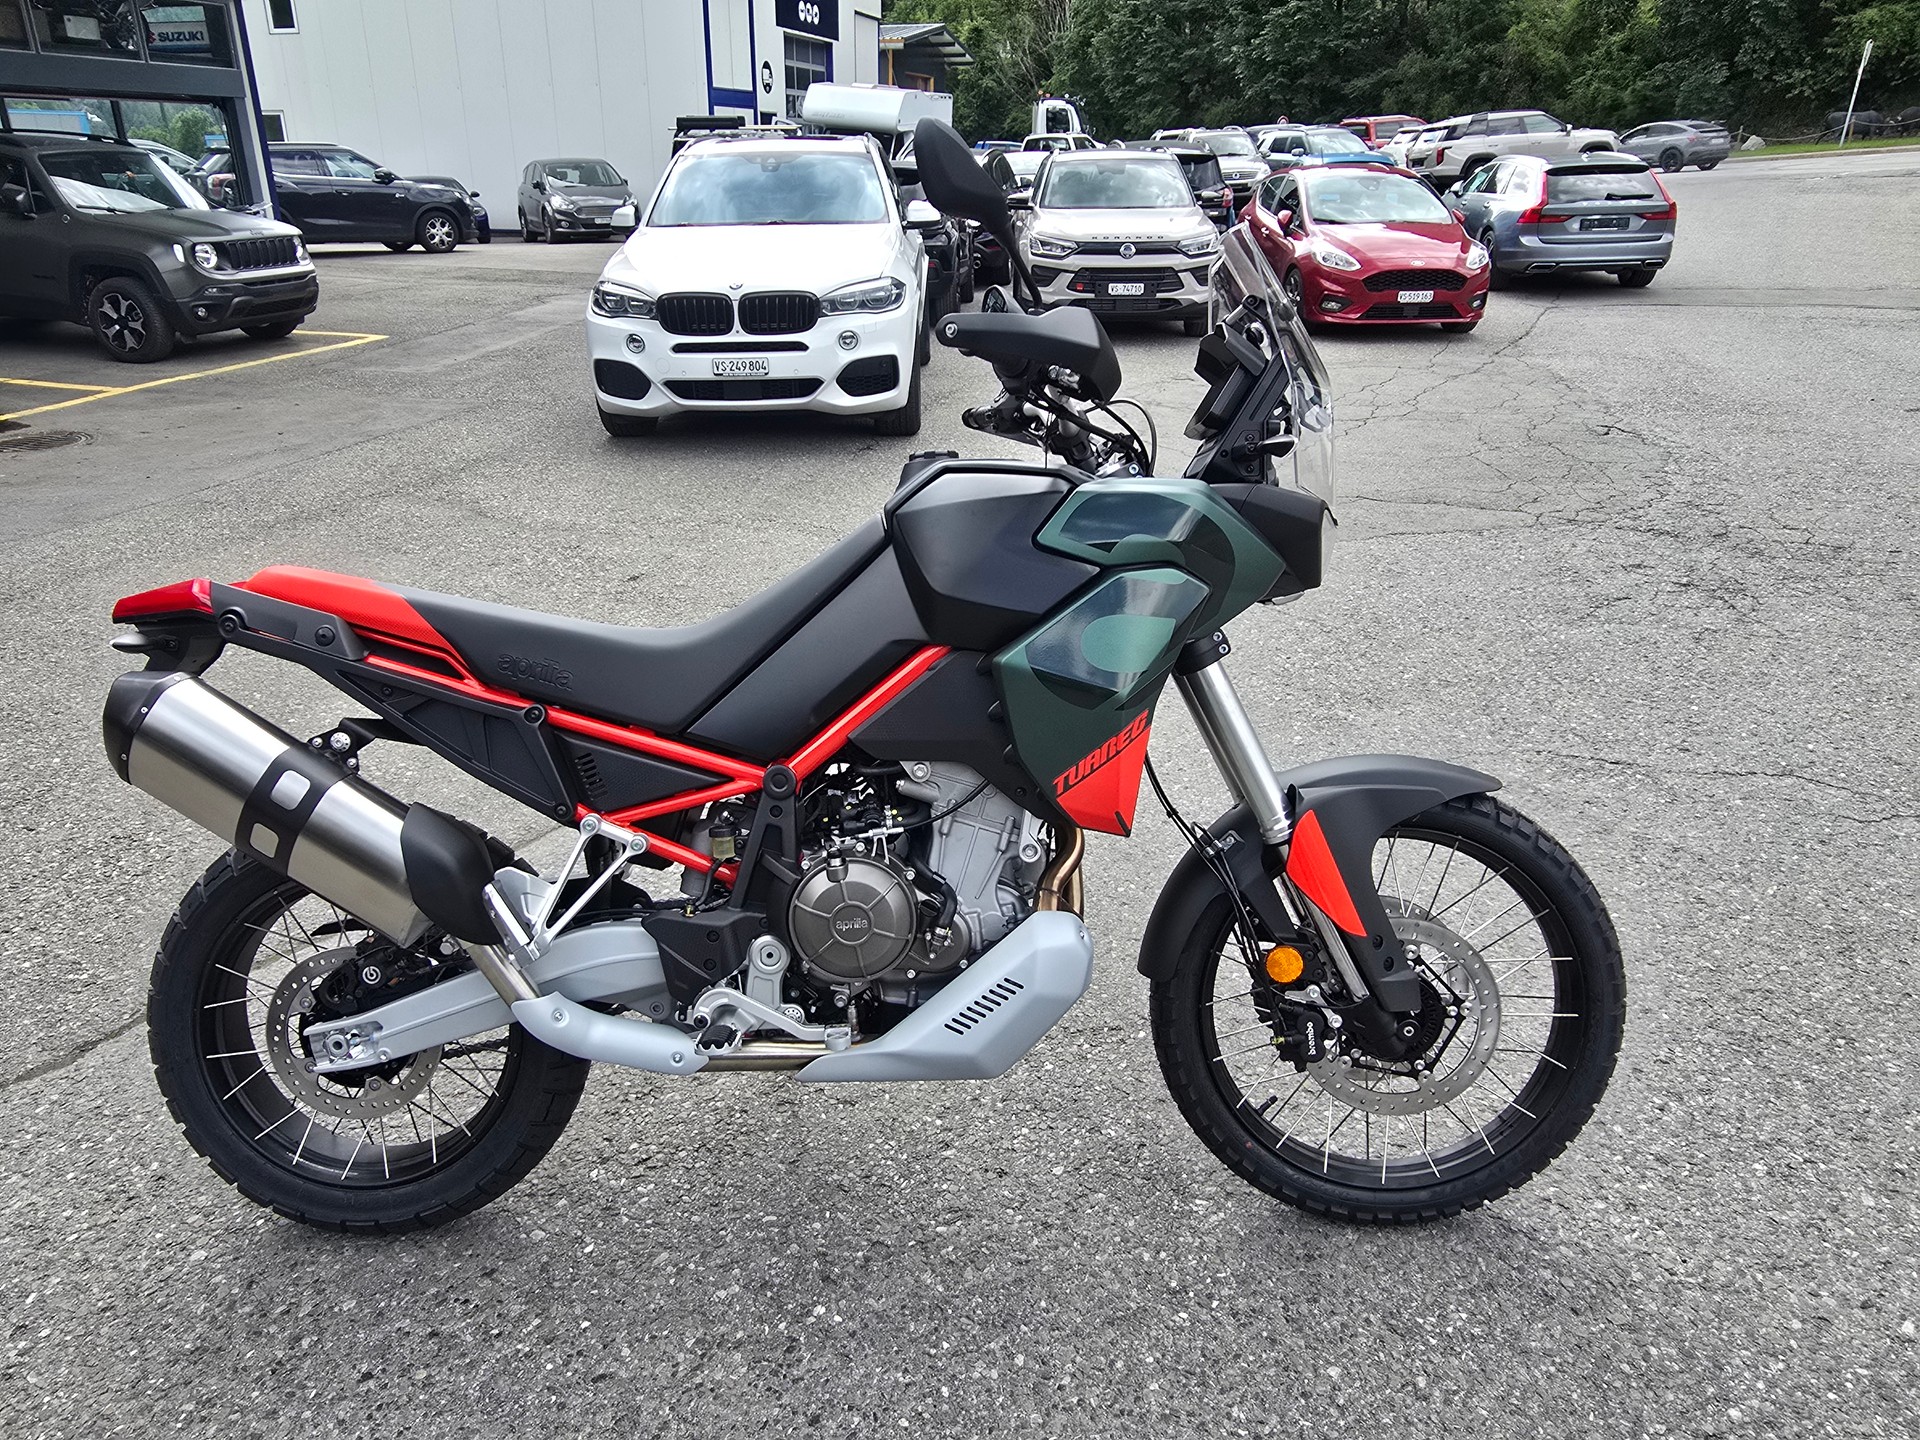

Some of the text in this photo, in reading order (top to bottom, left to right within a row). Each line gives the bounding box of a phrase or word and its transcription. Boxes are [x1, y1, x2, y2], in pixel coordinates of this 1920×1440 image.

[158, 30, 205, 42] SUZUKI
[498, 654, 575, 692] aprilia
[1052, 708, 1149, 795] TUAREG
[835, 917, 868, 932] aprilia
[1305, 1021, 1317, 1056] brembo
